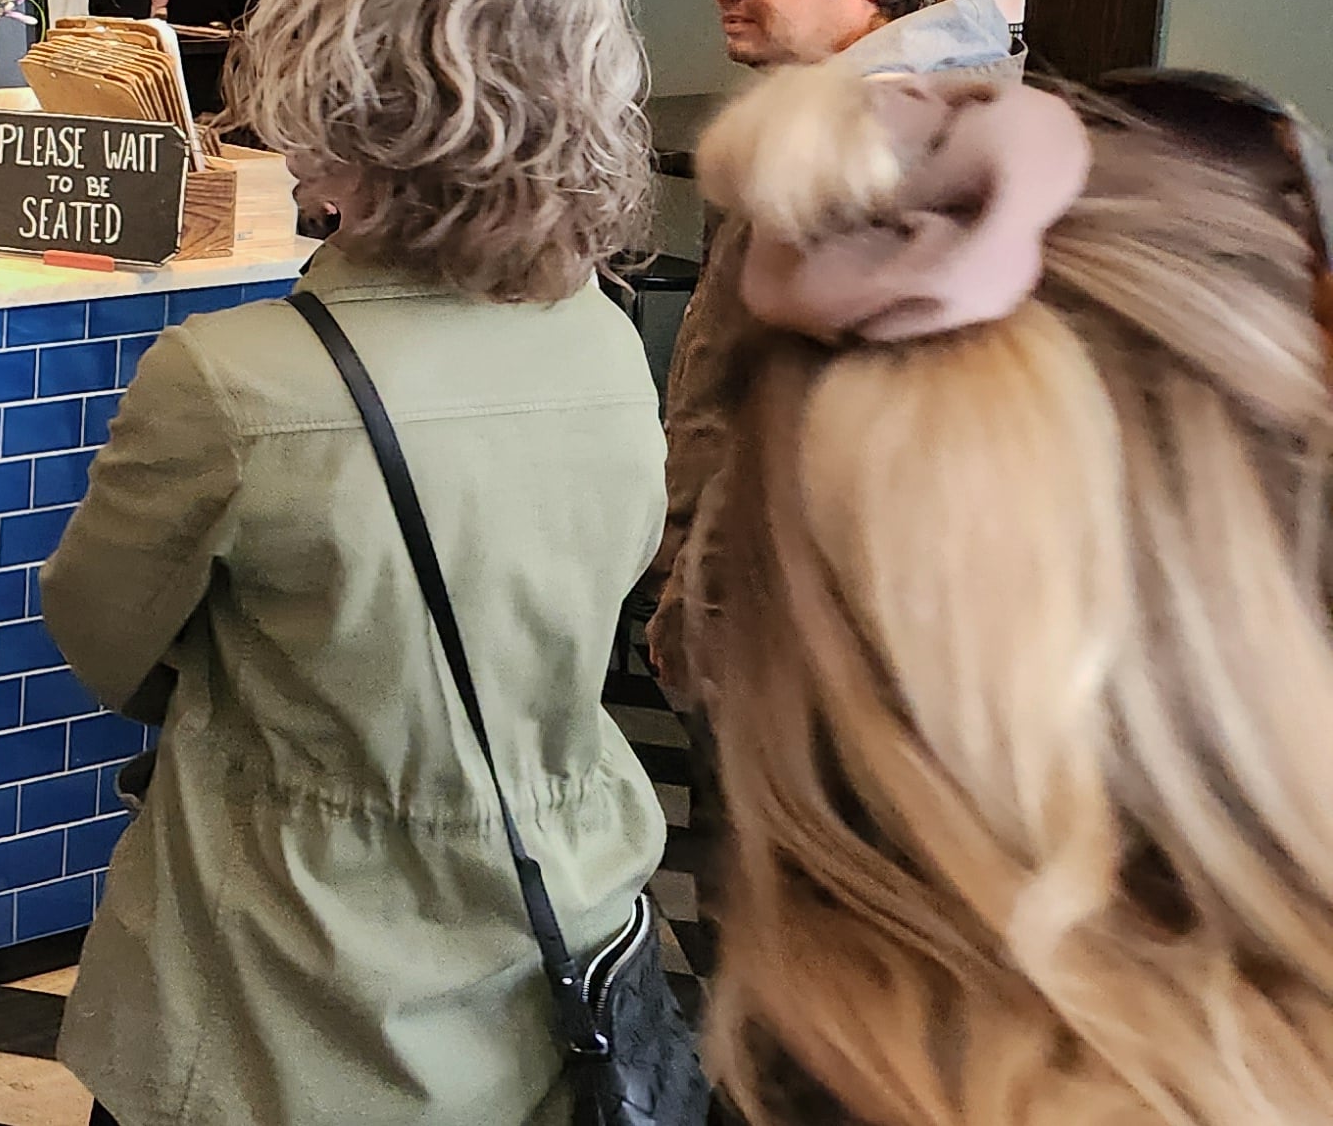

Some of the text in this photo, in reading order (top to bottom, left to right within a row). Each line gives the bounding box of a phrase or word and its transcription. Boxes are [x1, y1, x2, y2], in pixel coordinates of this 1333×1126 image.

[102, 129, 165, 173] WAIT
[46, 174, 111, 198] TO BE
[18, 196, 122, 245] SEATED
